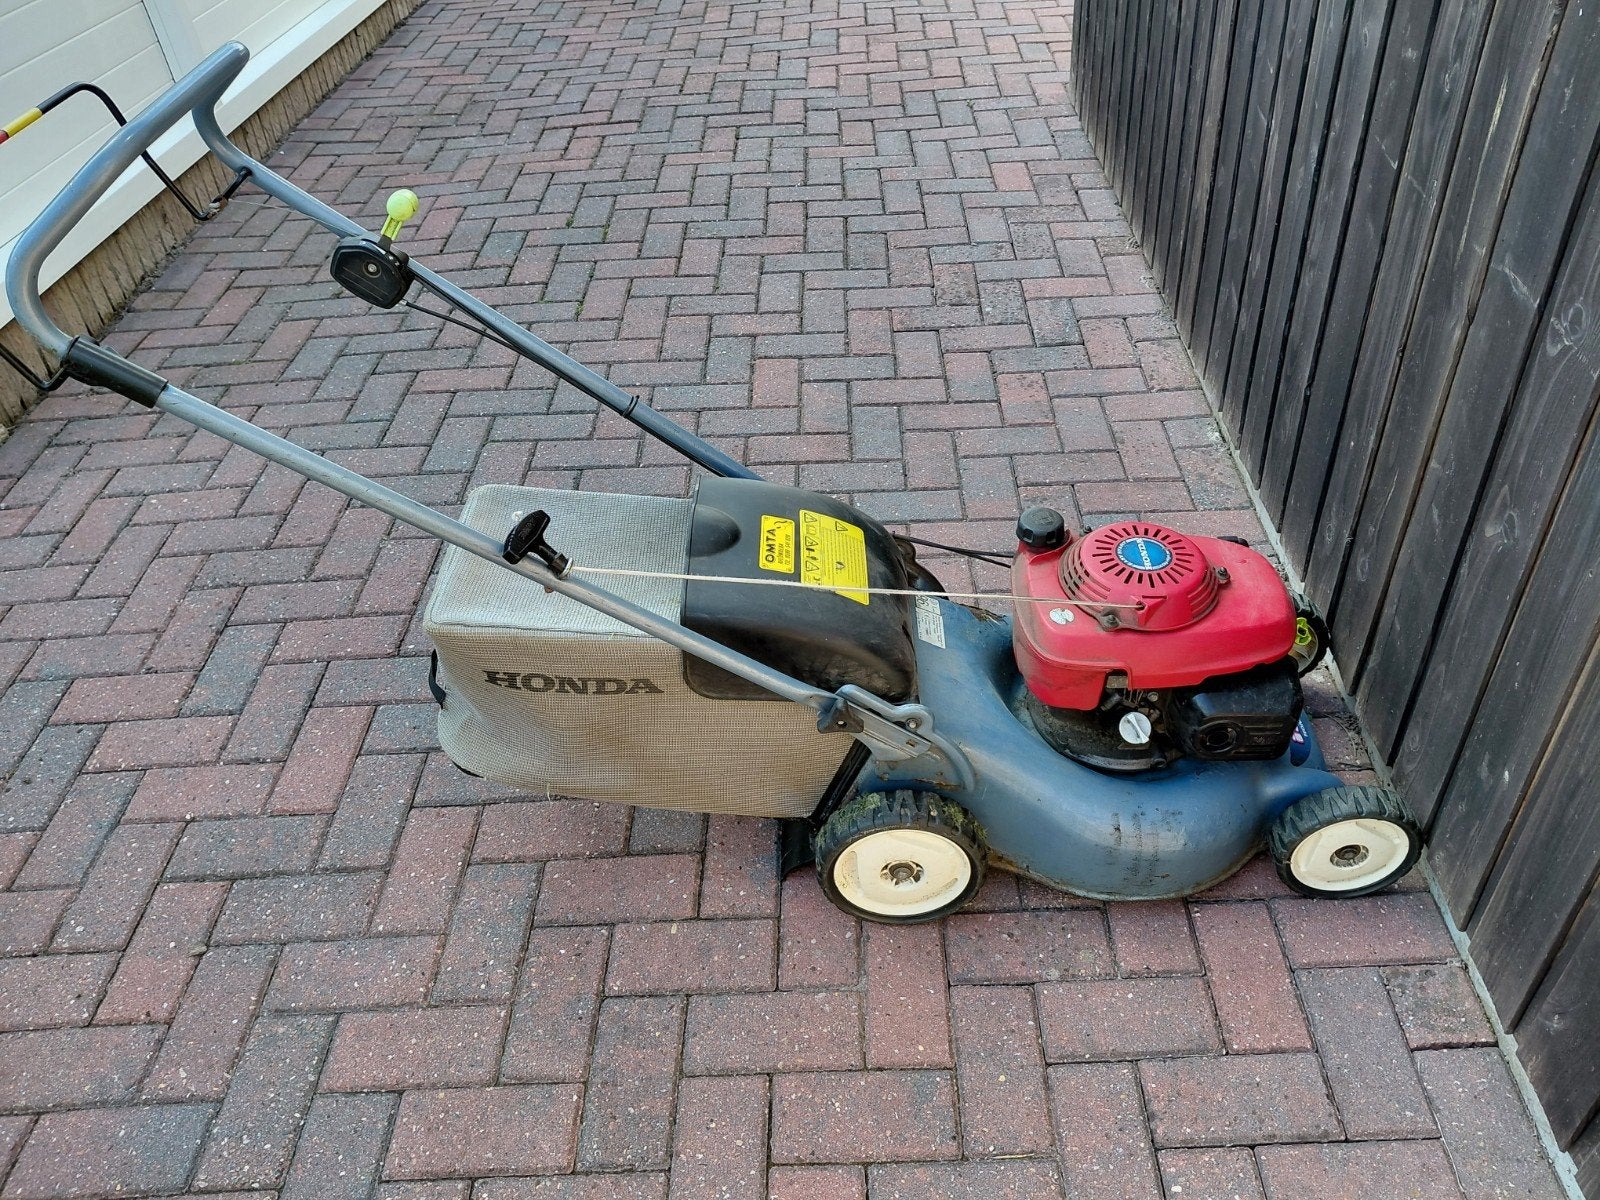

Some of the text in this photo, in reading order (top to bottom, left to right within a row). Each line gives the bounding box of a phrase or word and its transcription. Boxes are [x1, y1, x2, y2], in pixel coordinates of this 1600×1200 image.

[765, 529, 776, 563] OMTA
[1136, 538, 1153, 570] HONDA
[482, 670, 665, 695] HONDA
